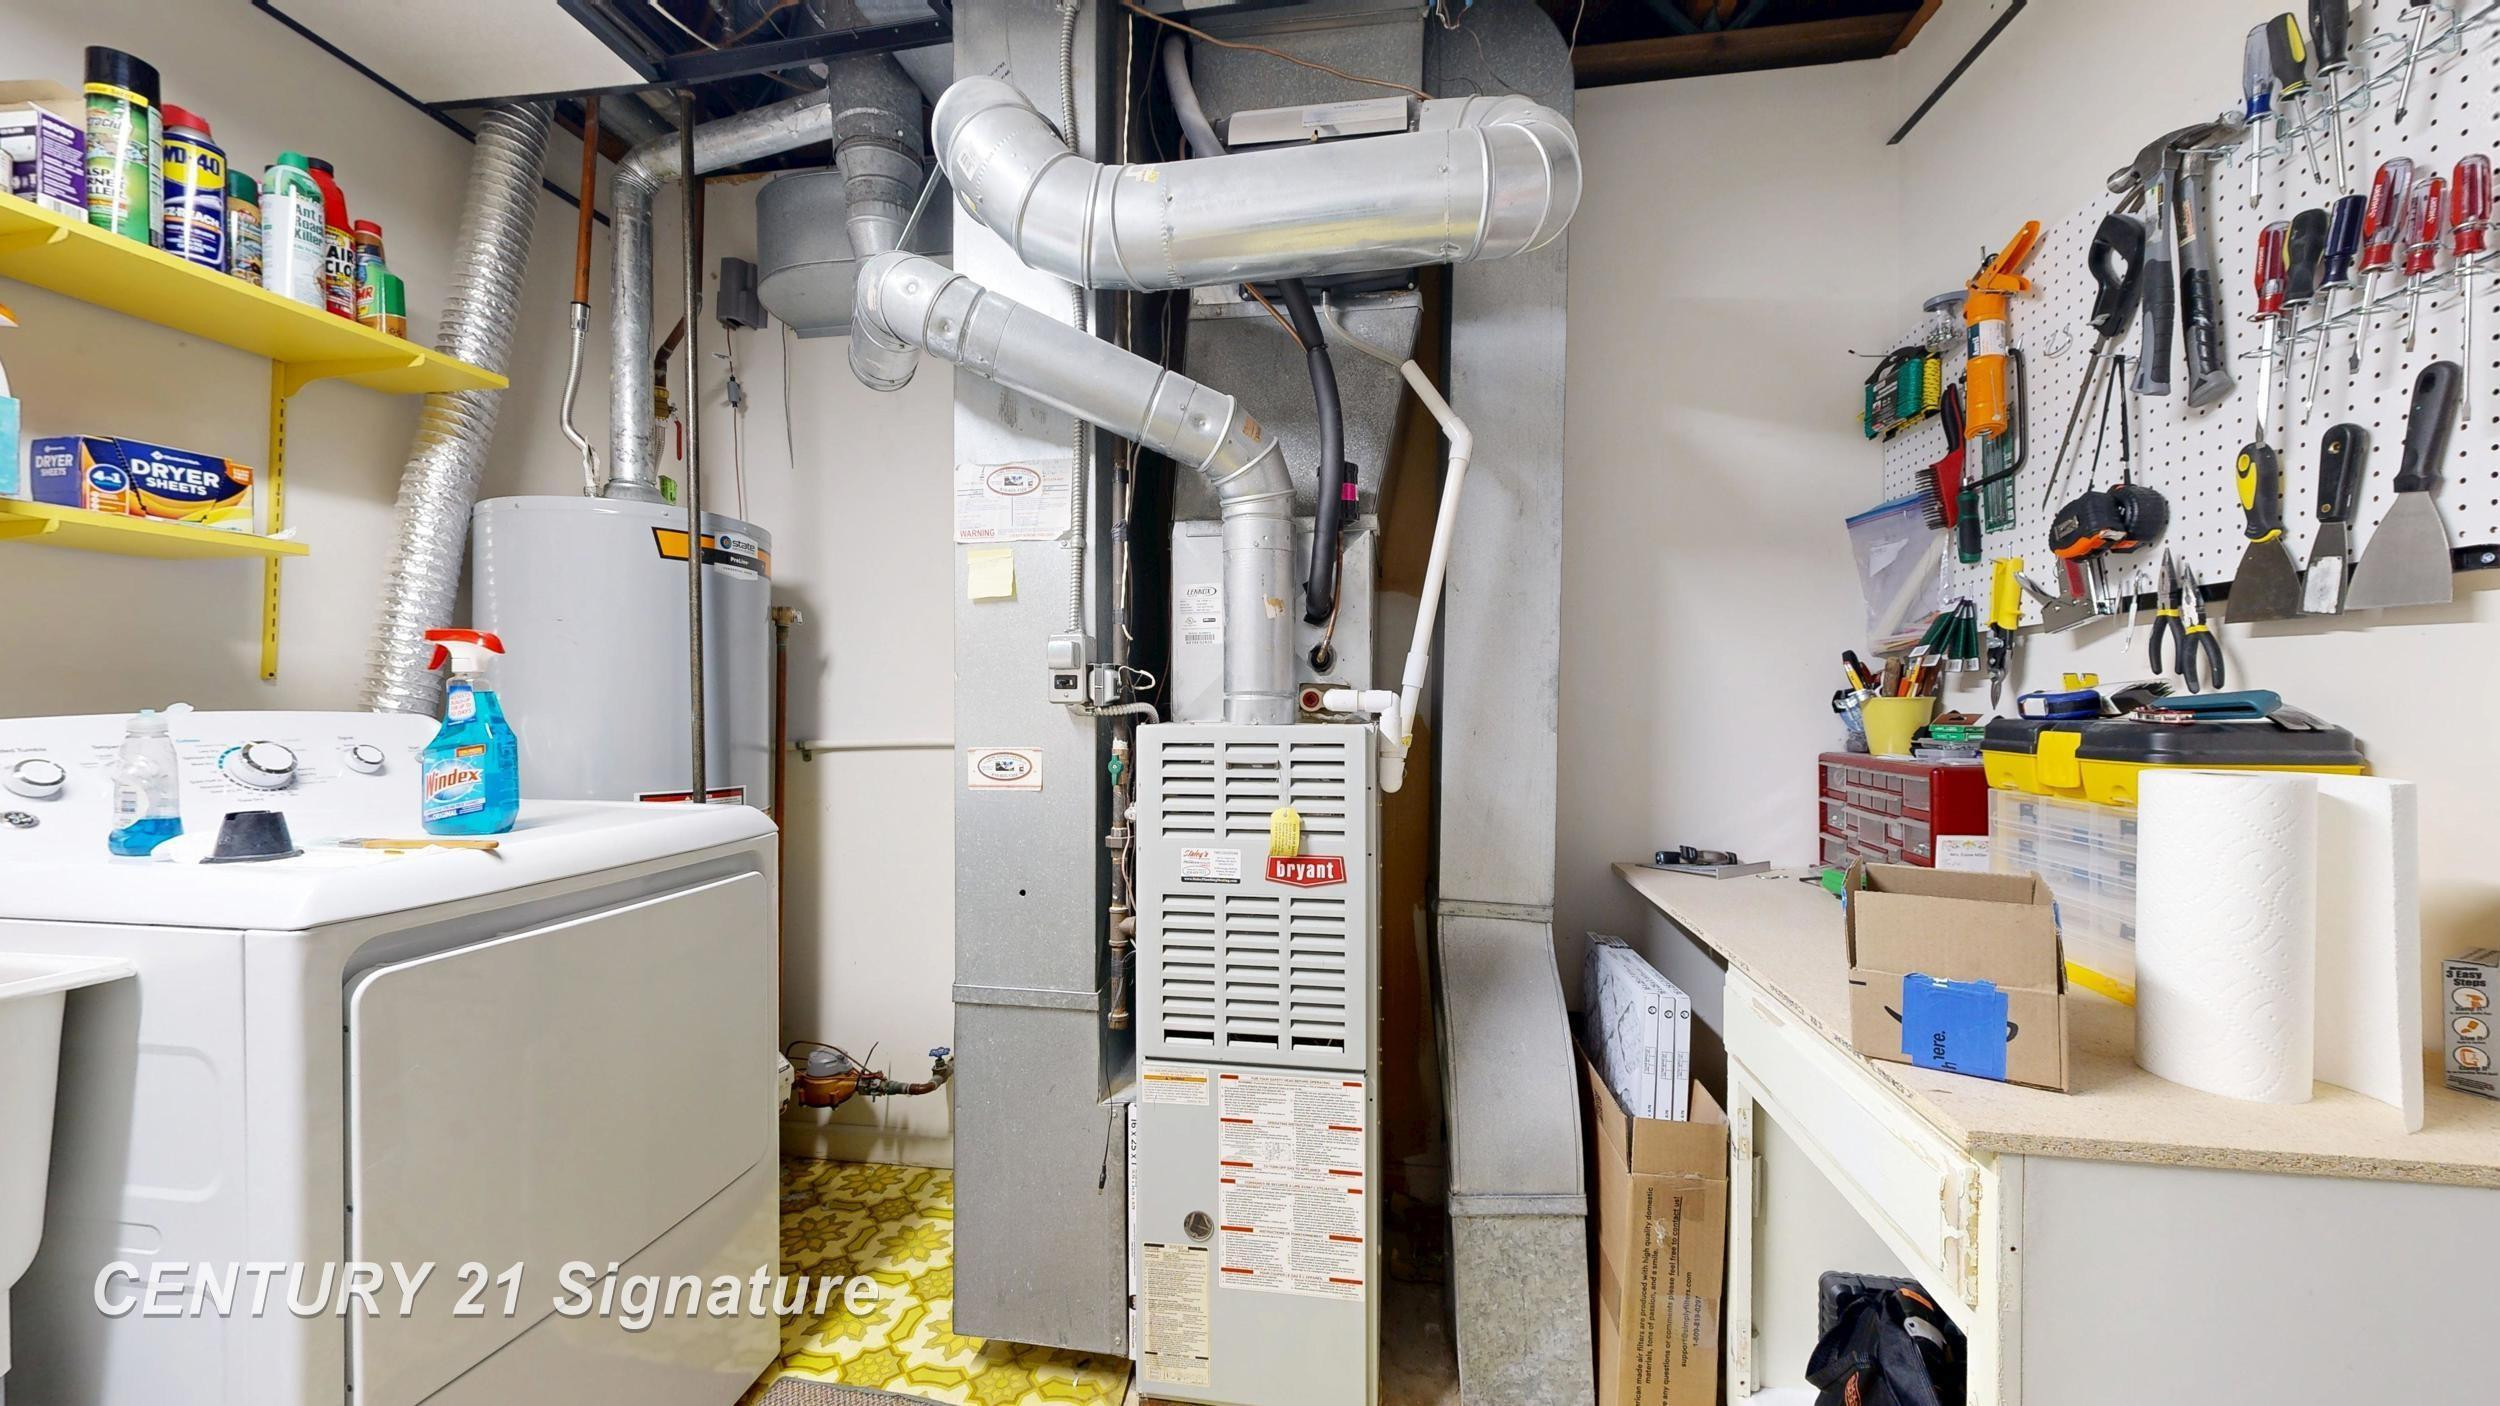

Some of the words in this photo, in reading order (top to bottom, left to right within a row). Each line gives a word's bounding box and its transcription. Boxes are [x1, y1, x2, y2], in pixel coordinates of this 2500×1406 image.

[295, 203, 316, 221] Ant
[294, 229, 324, 247] Killer
[35, 453, 74, 469] DRYER
[40, 466, 67, 477] SHEETS
[129, 458, 221, 489] DRYER
[145, 476, 208, 496] SHEETS
[960, 528, 996, 538] WARNING
[425, 769, 480, 798] Windex
[1276, 859, 1335, 881] bryant
[2446, 970, 2453, 978] 3
[2456, 970, 2483, 980] Easy
[2453, 978, 2487, 988] Steps
[1644, 1186, 1654, 1221] domestic
[1672, 1196, 1681, 1208] us!
[1671, 1208, 1680, 1237] contact
[1642, 1221, 1653, 1247] quality
[1641, 1247, 1651, 1264] high
[1649, 1248, 1659, 1269] smile.
[1669, 1246, 1677, 1262] free
[1640, 1264, 1649, 1282] with
[1668, 1262, 1677, 1277] feel
[1648, 1276, 1657, 1291] and
[1665, 1277, 1676, 1301] please
[1639, 1281, 1649, 1317] produced
[1647, 1292, 1657, 1321] passion,
[1638, 1317, 1646, 1330] are
[1646, 1322, 1655, 1331] of
[1665, 1301, 1674, 1339] comments
[1635, 1330, 1645, 1352] filters
[1646, 1331, 1654, 1347] tons
[1635, 1352, 1644, 1363] air
[1644, 1348, 1654, 1384] materials,
[1635, 1363, 1643, 1385] made
[1662, 1350, 1672, 1386] questions
[1662, 1385, 1672, 1400] any
